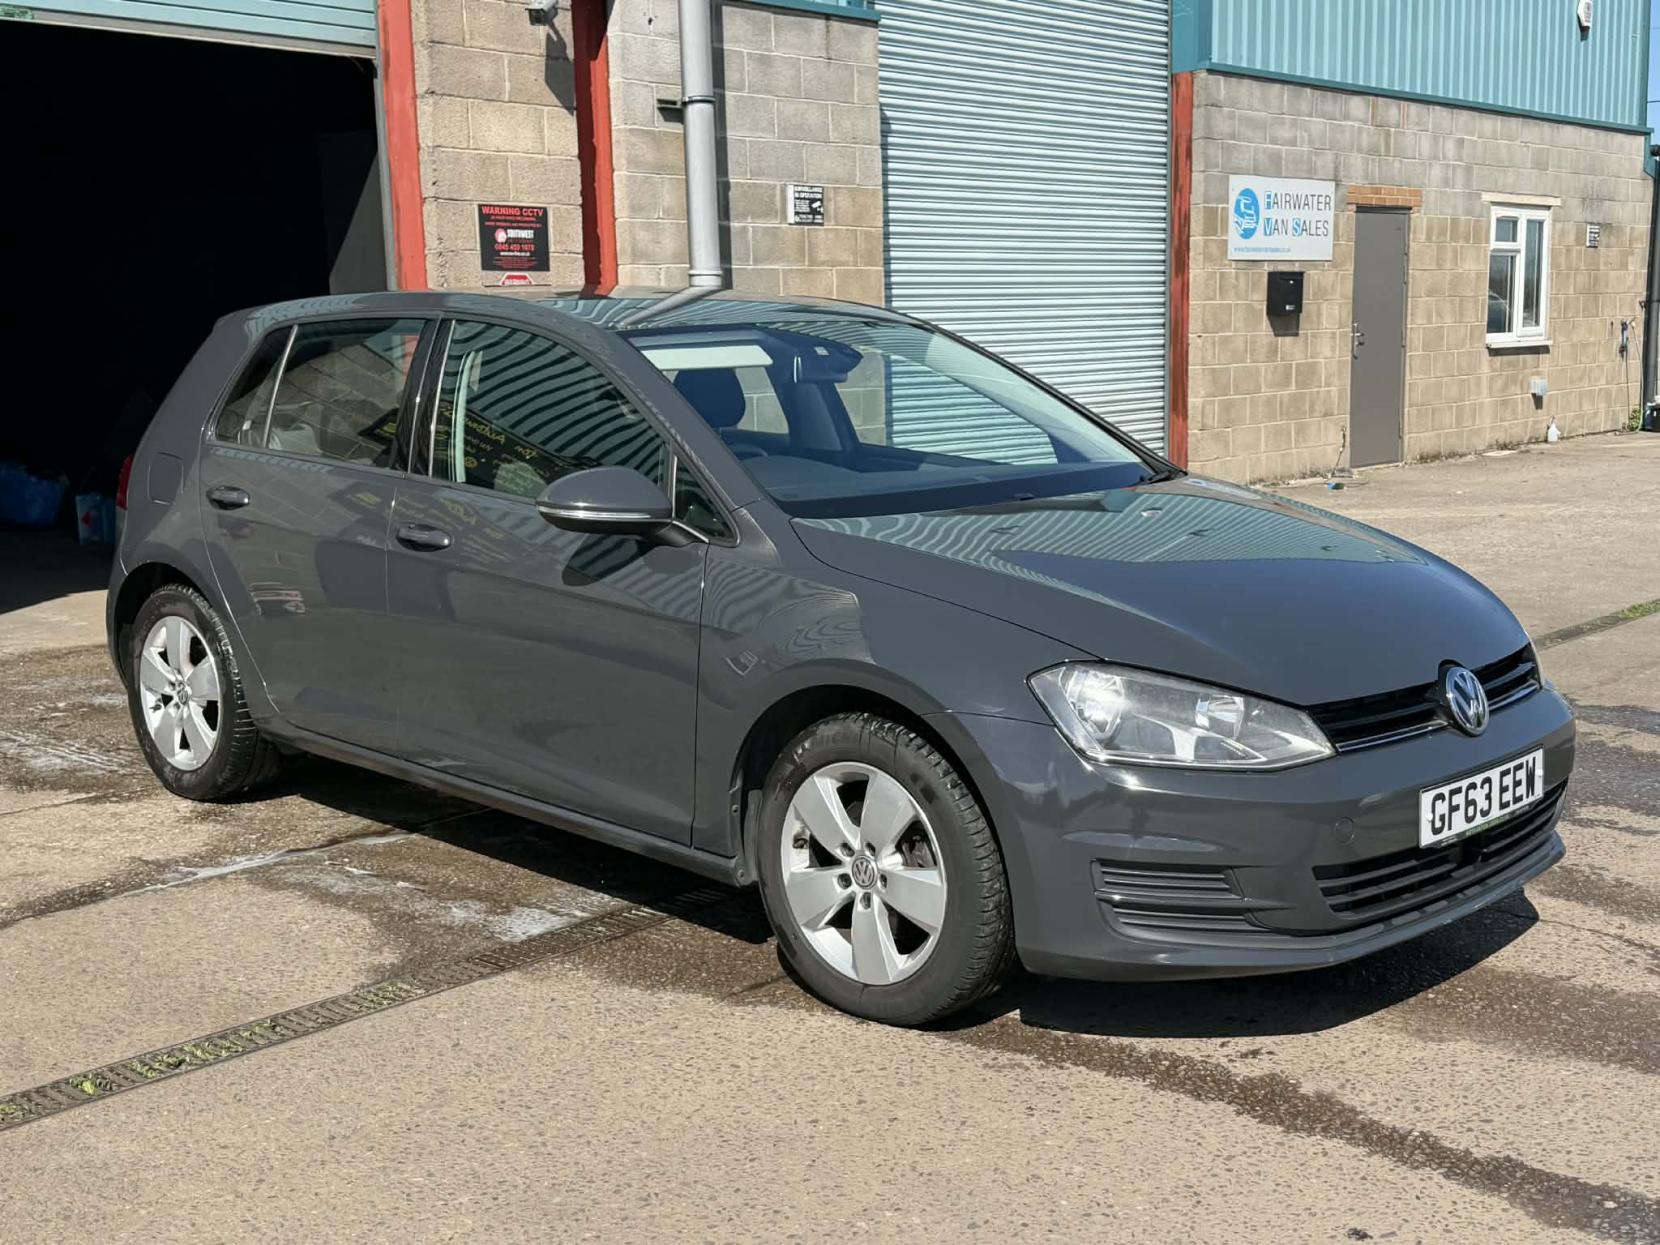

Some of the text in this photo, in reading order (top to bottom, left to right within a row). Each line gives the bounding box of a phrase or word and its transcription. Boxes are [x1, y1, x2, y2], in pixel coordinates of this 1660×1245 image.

[482, 206, 544, 216] WARNING CCTV
[1264, 191, 1332, 211] FAIRWATER
[1264, 217, 1330, 237] VAN SALES
[1431, 756, 1536, 836] GF63 EEW
